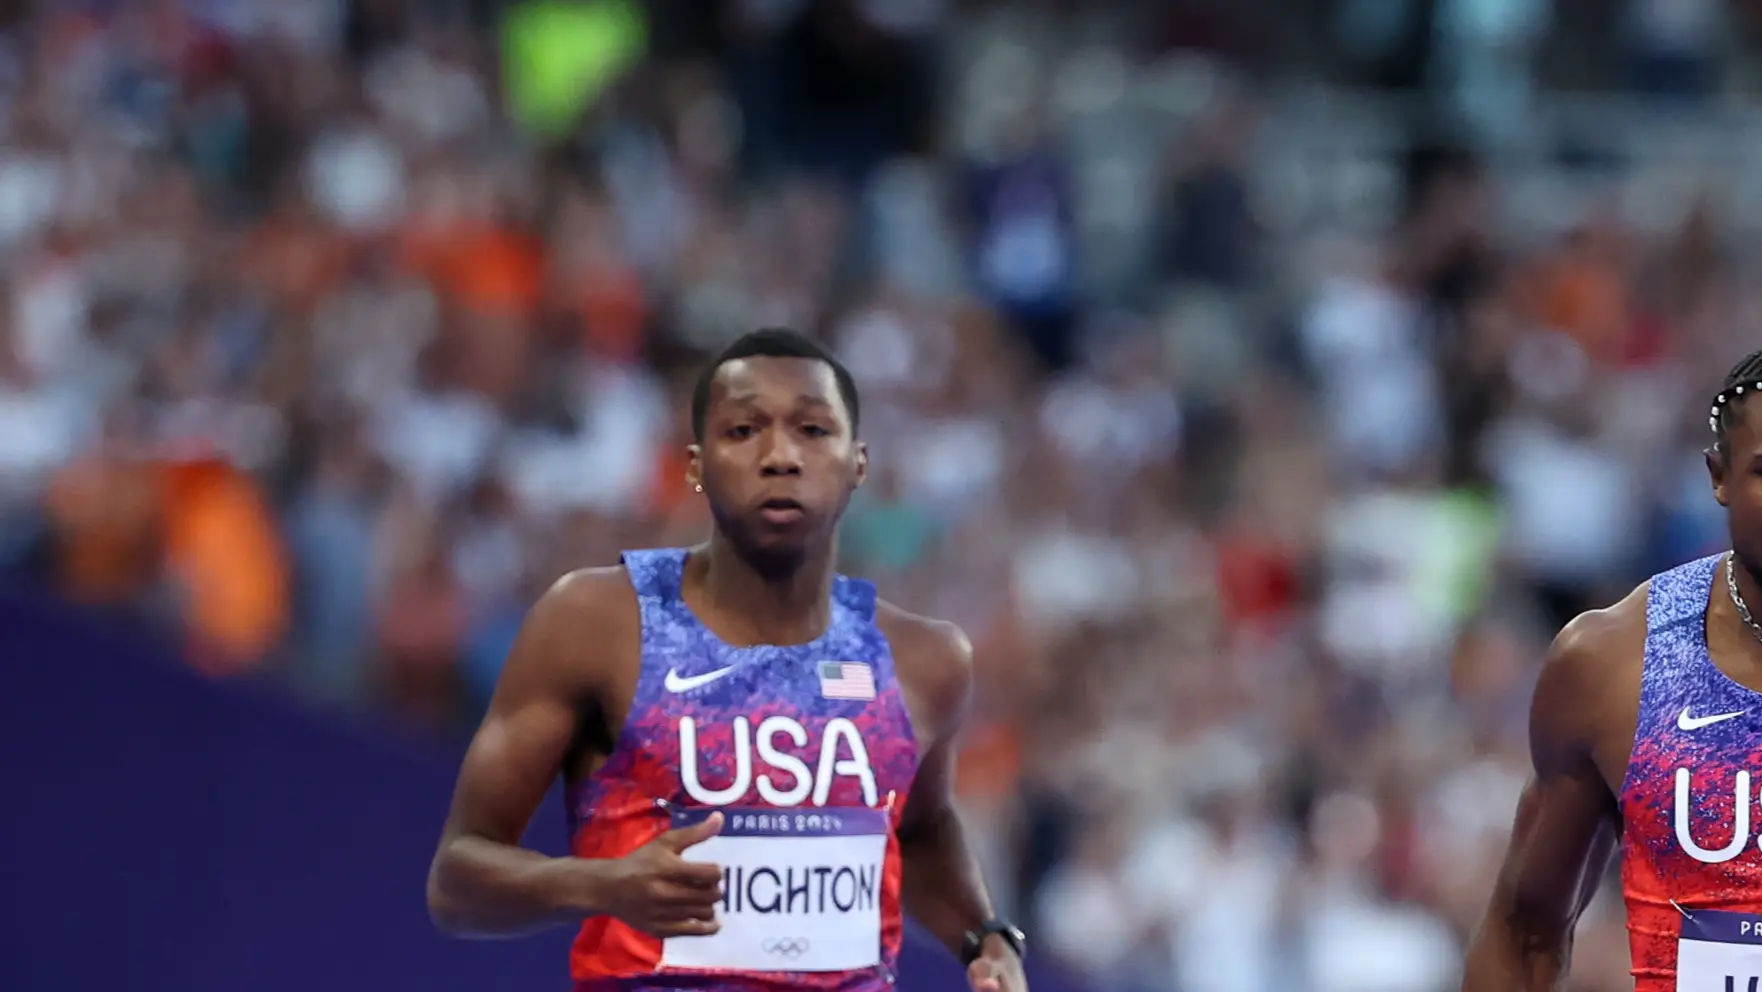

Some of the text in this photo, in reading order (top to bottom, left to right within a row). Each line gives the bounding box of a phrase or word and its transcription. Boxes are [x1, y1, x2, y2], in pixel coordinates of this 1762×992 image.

[679, 716, 878, 807] USA
[732, 814, 790, 831] PARIS
[722, 865, 876, 914] IGHTON
